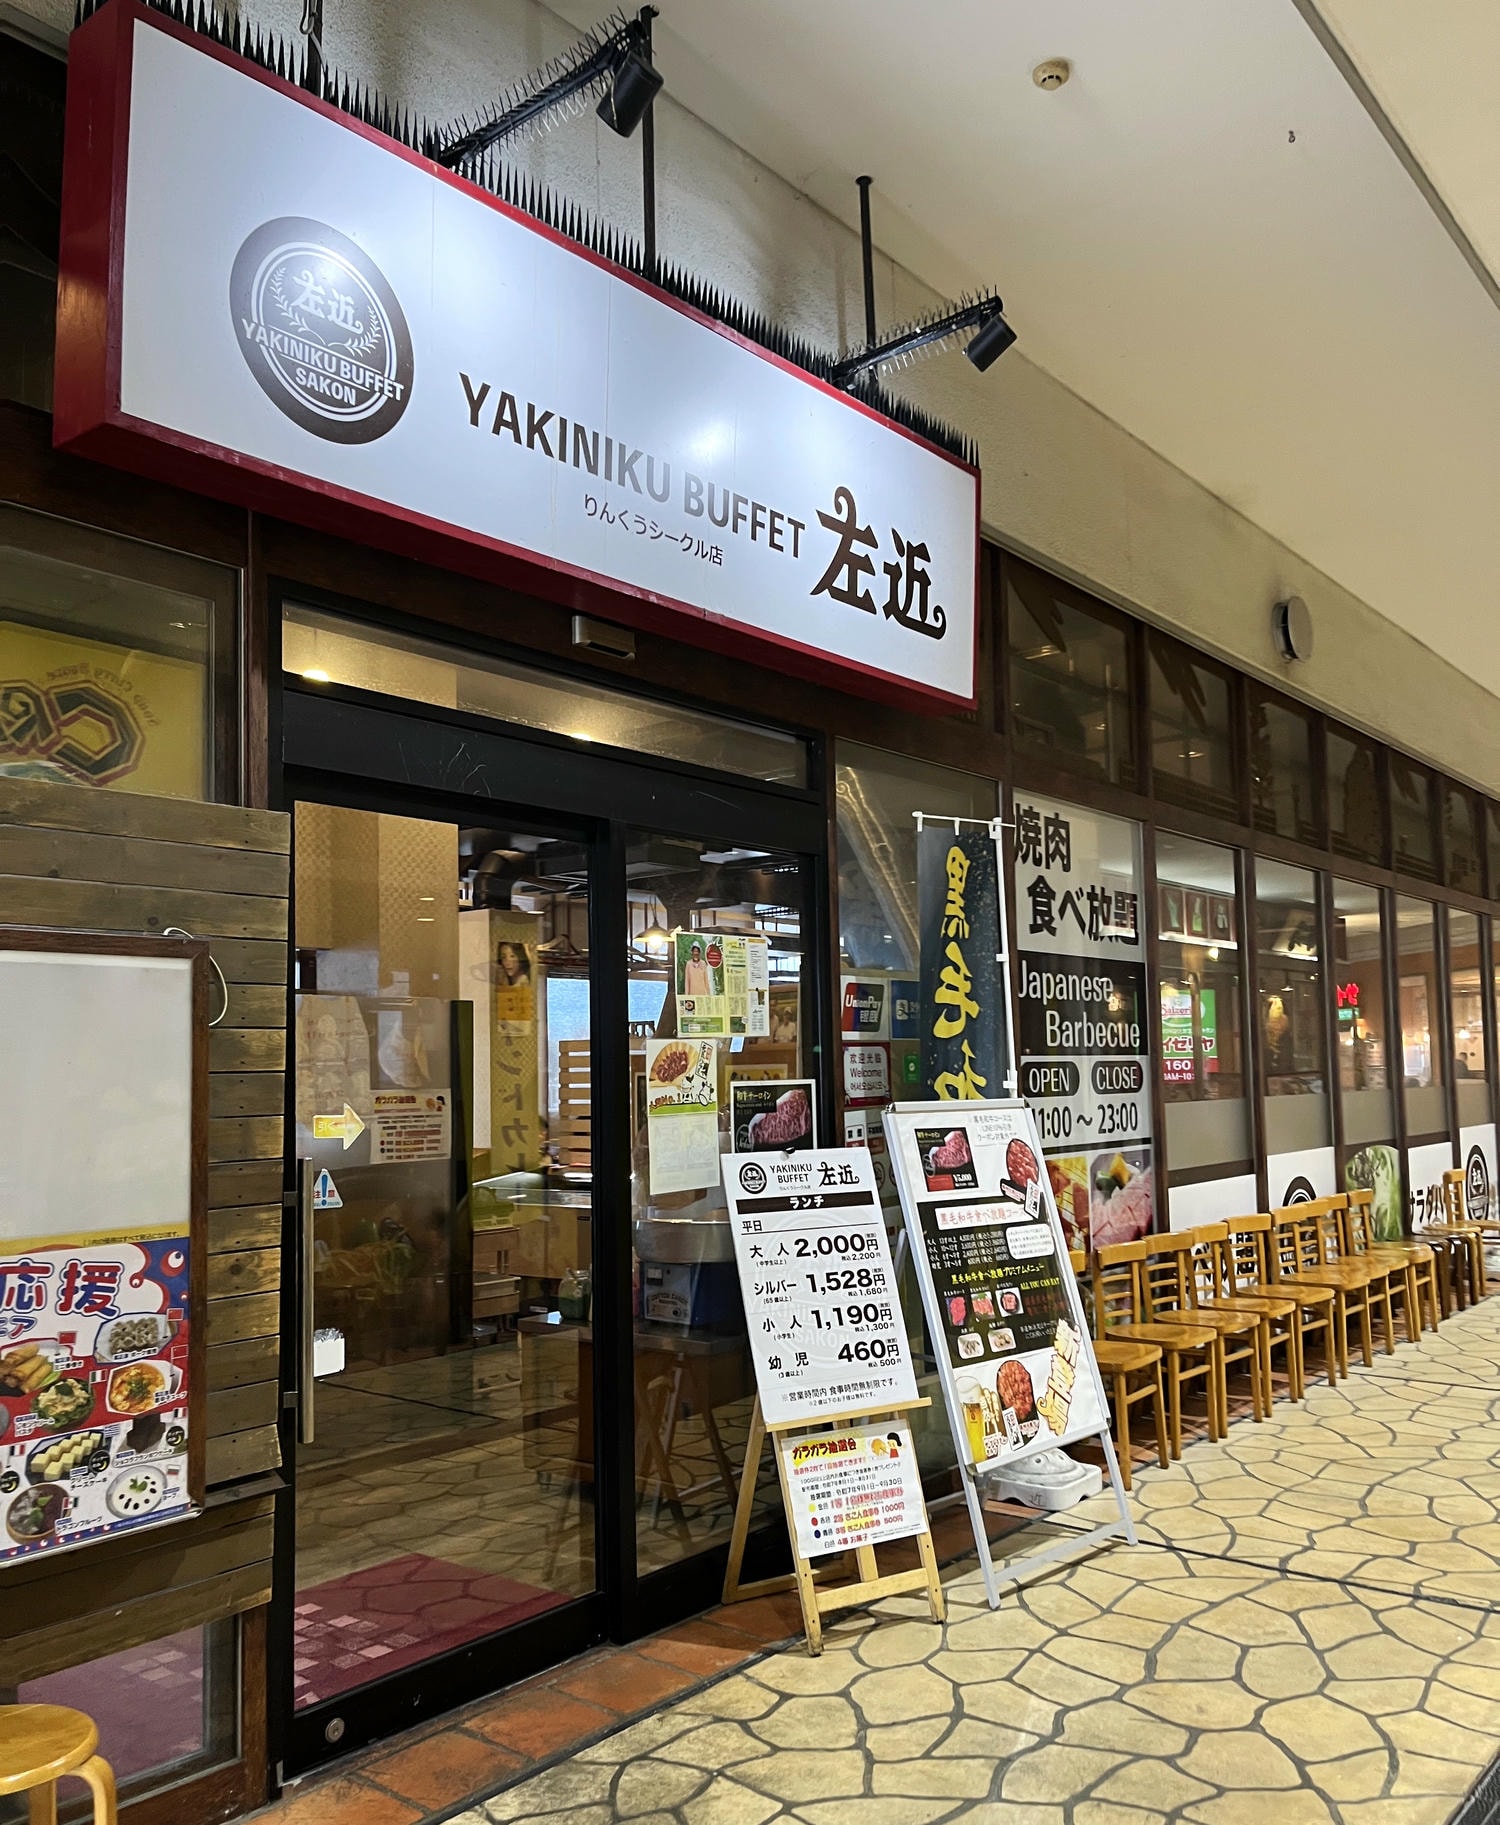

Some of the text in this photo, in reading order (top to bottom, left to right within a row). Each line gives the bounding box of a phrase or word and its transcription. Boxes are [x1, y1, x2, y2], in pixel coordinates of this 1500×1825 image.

[291, 270, 364, 334] 左近
[241, 318, 404, 401] YAKINIKU BUFFET
[295, 367, 356, 406] SAKON
[459, 371, 805, 559] YAKINIKU BUFFET
[584, 494, 723, 566] りんくうシークル店
[809, 486, 946, 640] 左近
[1014, 803, 1071, 873] 焼肉
[1027, 875, 1139, 946] 食べ放題
[845, 995, 881, 1009] UnionPay
[1018, 960, 1114, 1006] Japanese
[1046, 1010, 1140, 1048] Barbecue
[850, 1068, 882, 1079] Welcome
[1028, 1066, 1138, 1093] OPEN CLOSE
[1097, 1102, 1138, 1134] 23:00
[770, 1163, 812, 1174] YAKINIKU
[778, 1174, 809, 1184] BUFFET
[817, 1161, 859, 1187] 左近
[789, 1195, 824, 1209] ランチ
[742, 1220, 763, 1232] 平日
[0, 1257, 123, 1318] 応援
[754, 1280, 797, 1295] シルバー
